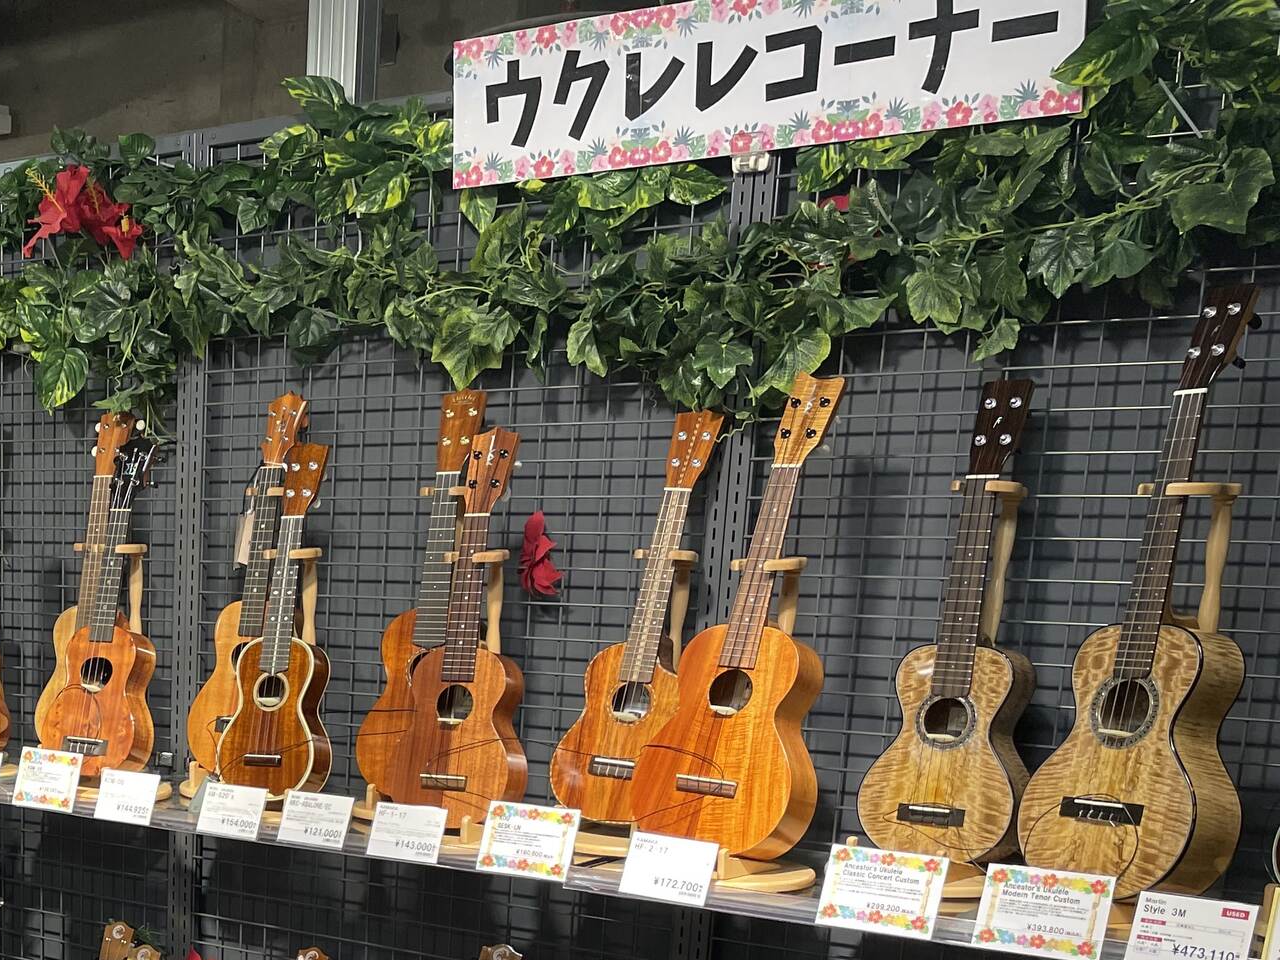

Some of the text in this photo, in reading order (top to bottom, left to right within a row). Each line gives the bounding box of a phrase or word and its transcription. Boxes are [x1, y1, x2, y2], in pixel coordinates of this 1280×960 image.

[485, 0, 1060, 147] ウクレレコーナー
[1144, 903, 1187, 920] Style 3M
[1226, 911, 1246, 920] USED
